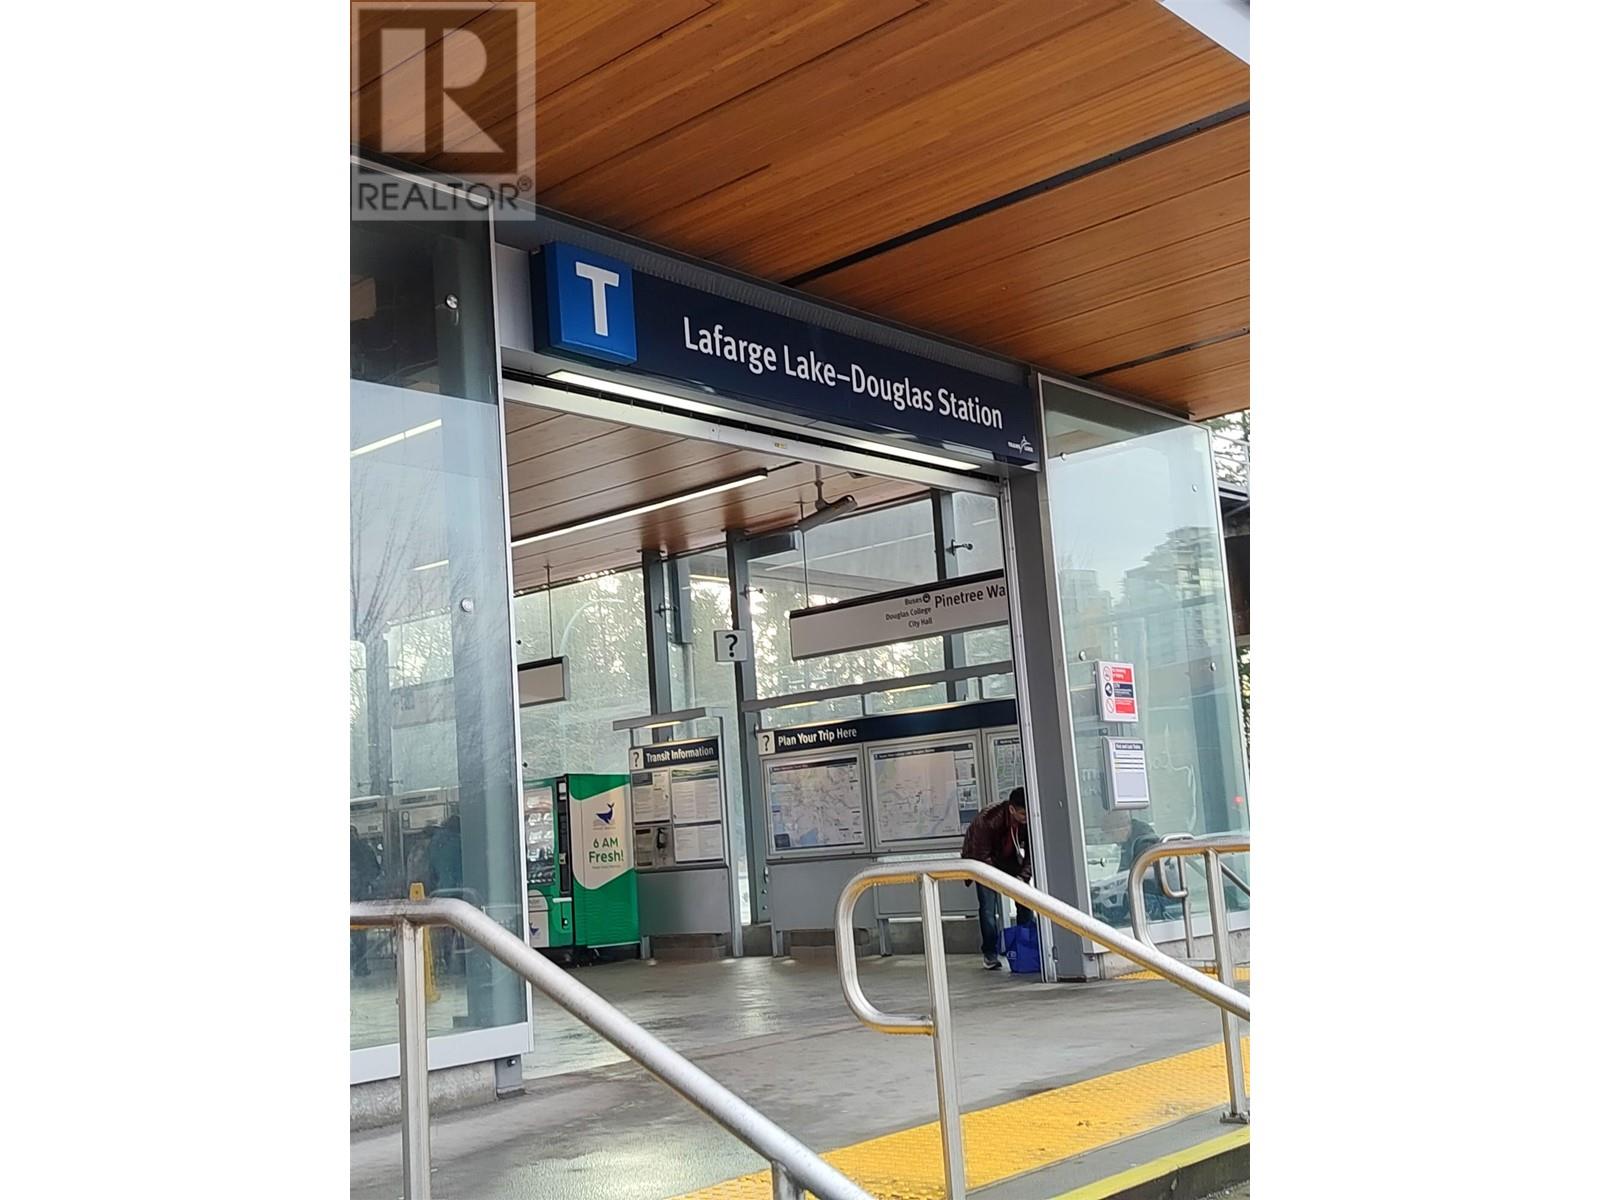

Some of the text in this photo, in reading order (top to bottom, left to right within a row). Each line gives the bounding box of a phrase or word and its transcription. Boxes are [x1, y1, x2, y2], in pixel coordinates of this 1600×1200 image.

[575, 261, 620, 337] T
[683, 316, 777, 375] Lafarge
[938, 388, 1004, 430] Station
[904, 597, 923, 606] Buses
[934, 590, 984, 609] Pinetree
[885, 607, 932, 621] Douglas College
[908, 617, 933, 629] City Hall
[777, 733, 797, 747] Plan
[797, 731, 817, 744] Your
[817, 729, 835, 743] Trip
[836, 727, 857, 739] Here
[646, 749, 671, 763] Transit
[671, 746, 714, 760] Information
[593, 837, 619, 849] 6 AM
[588, 849, 625, 863] Fresh!
